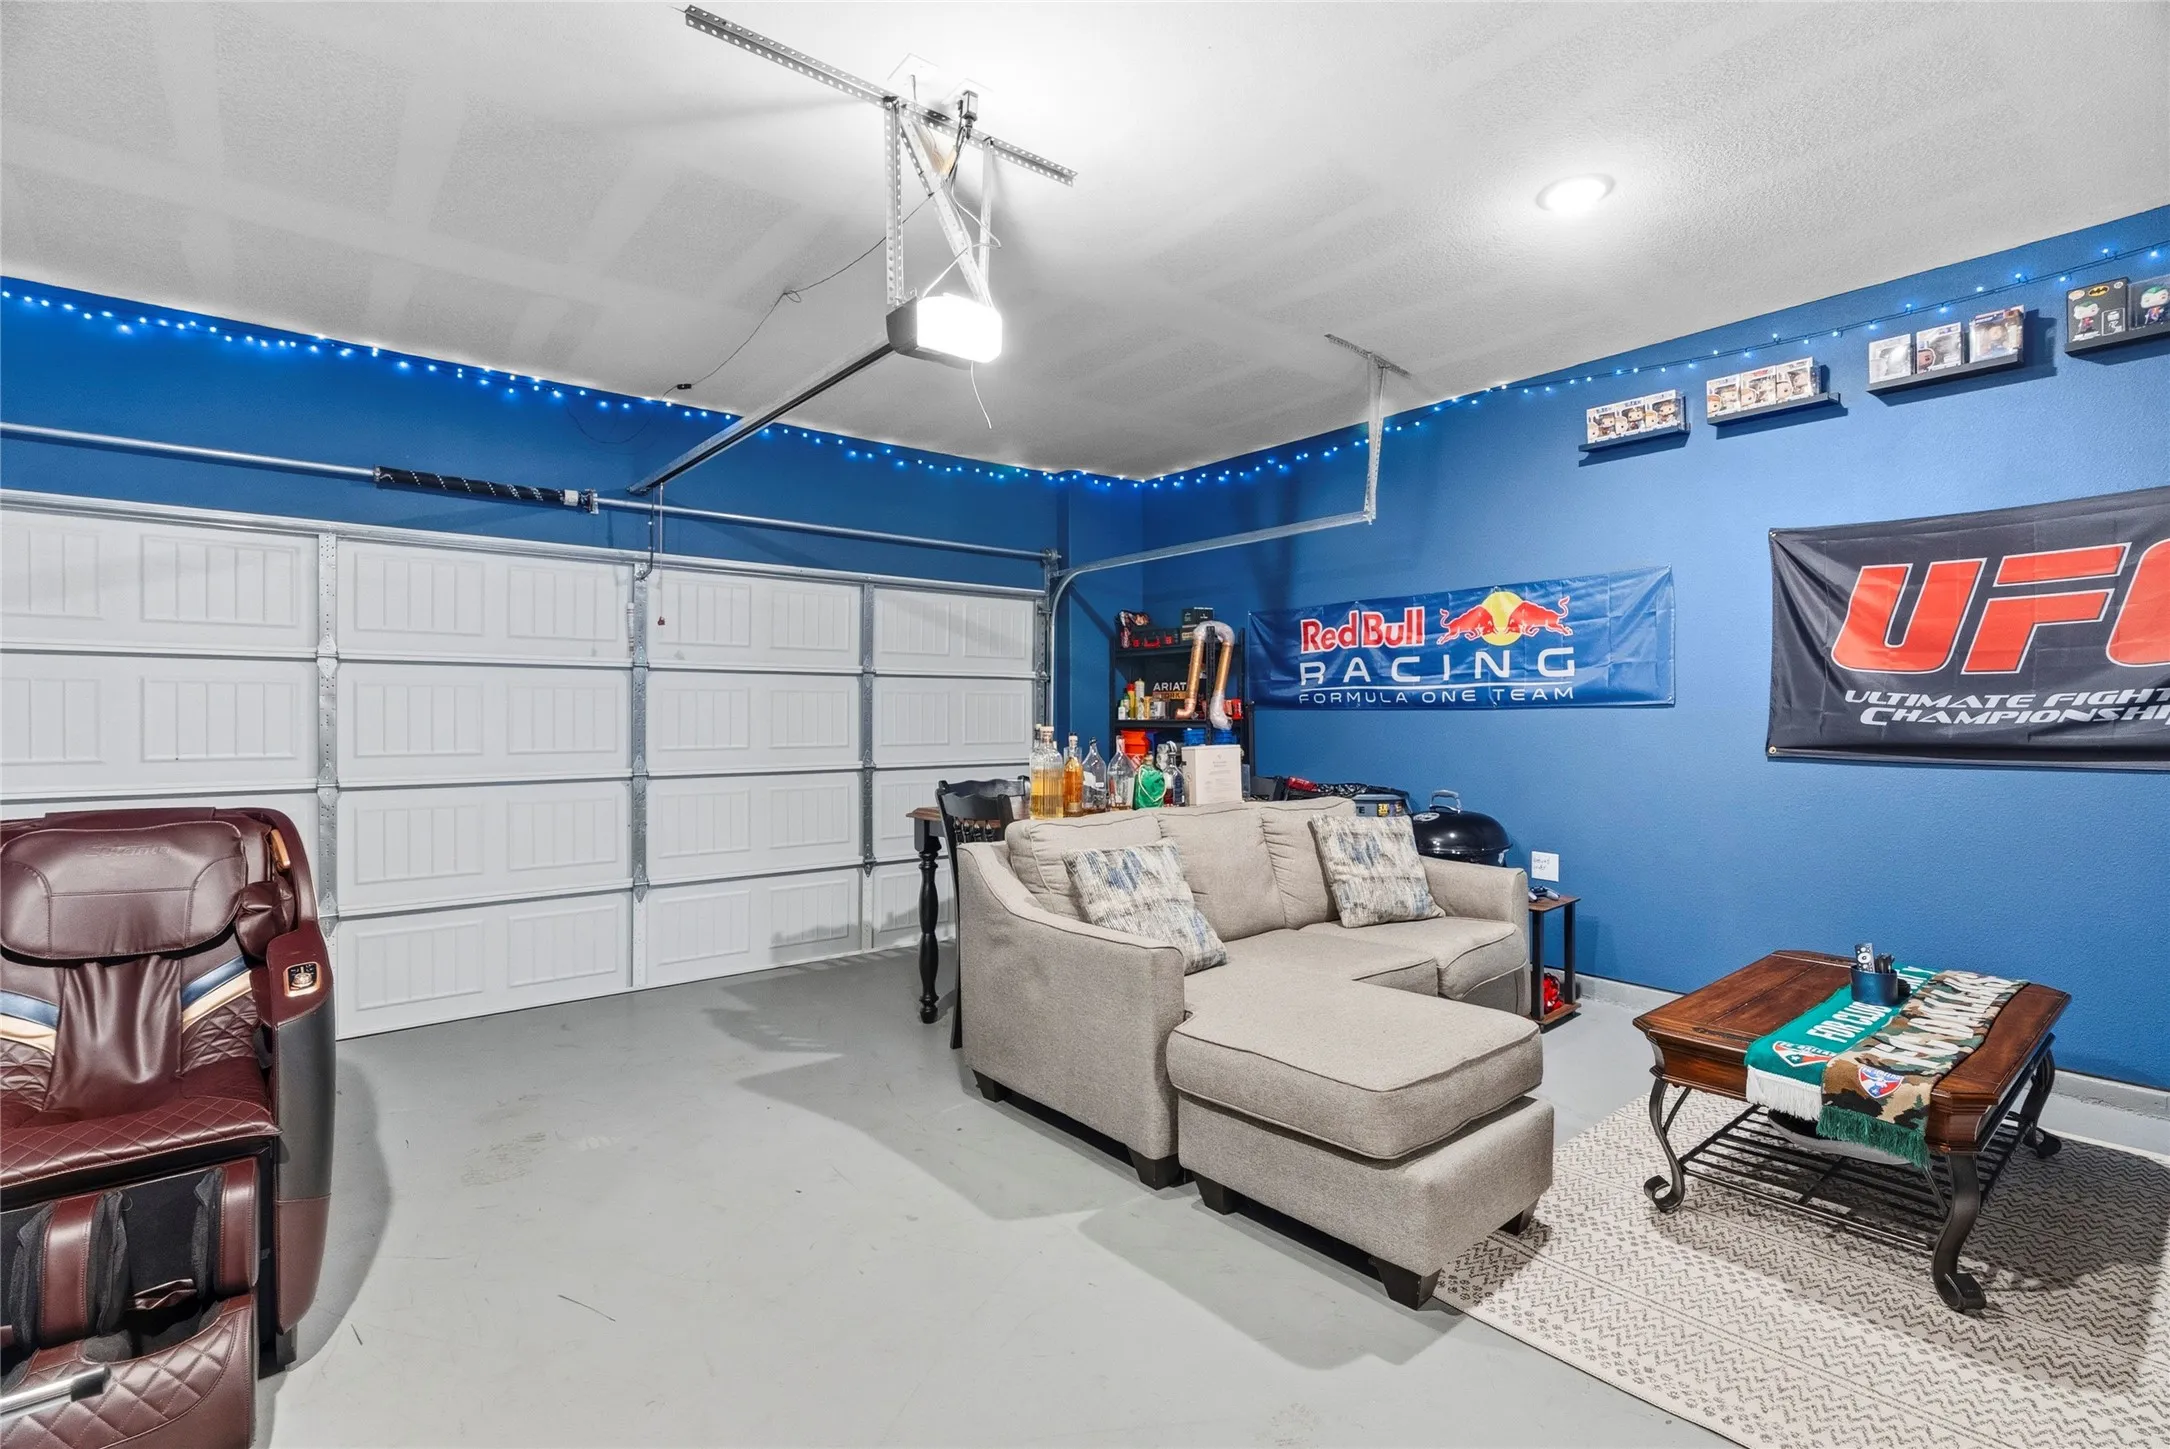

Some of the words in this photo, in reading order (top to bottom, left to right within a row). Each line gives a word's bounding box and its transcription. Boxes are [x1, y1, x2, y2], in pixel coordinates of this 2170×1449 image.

[1300, 609, 1359, 654] Red
[1361, 605, 1425, 648] Bull
[1300, 646, 1575, 685] RACING
[1153, 681, 1187, 691] ARIAT
[1299, 691, 1407, 705] FORMULA
[1422, 689, 1476, 703] ONE
[1493, 686, 1575, 702] TEAM
[1845, 689, 2036, 708] ULTIMATE
[1859, 704, 2170, 726] CHAMPIONSHI
[1832, 1001, 1892, 1026] CLUB
[1806, 1020, 1866, 1043] FOR
